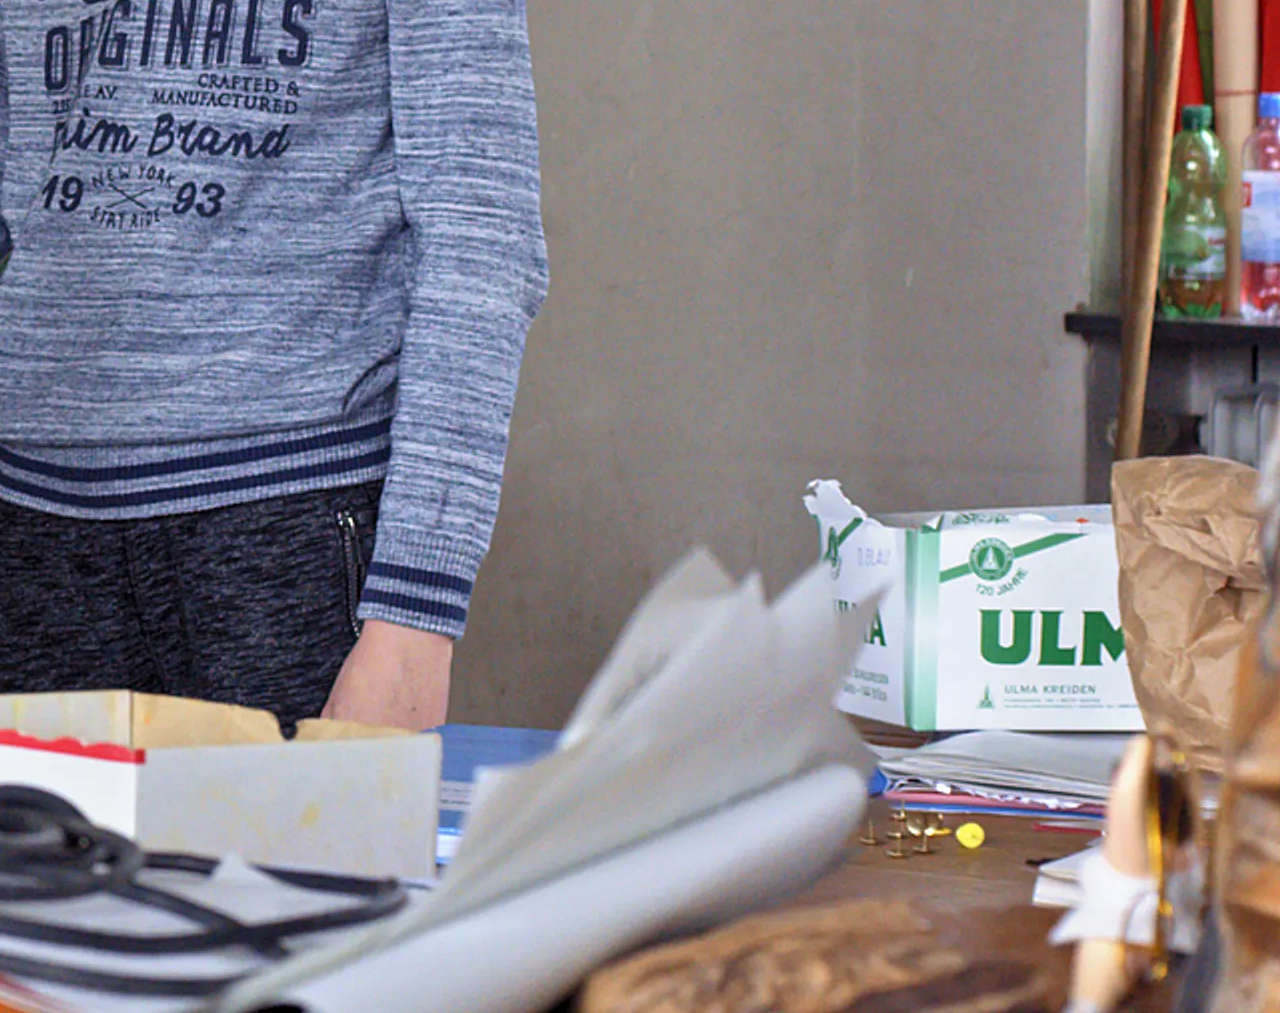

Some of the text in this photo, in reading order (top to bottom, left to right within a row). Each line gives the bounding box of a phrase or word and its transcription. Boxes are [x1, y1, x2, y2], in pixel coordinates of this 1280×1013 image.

[197, 73, 300, 96] CRAFTED &
[151, 89, 298, 115] MANUFACTURED
[147, 112, 290, 159] Brand
[91, 163, 177, 189] NEW YORK
[41, 175, 226, 219] 19 93
[1004, 684, 1097, 695] ULMA KREIDEN
